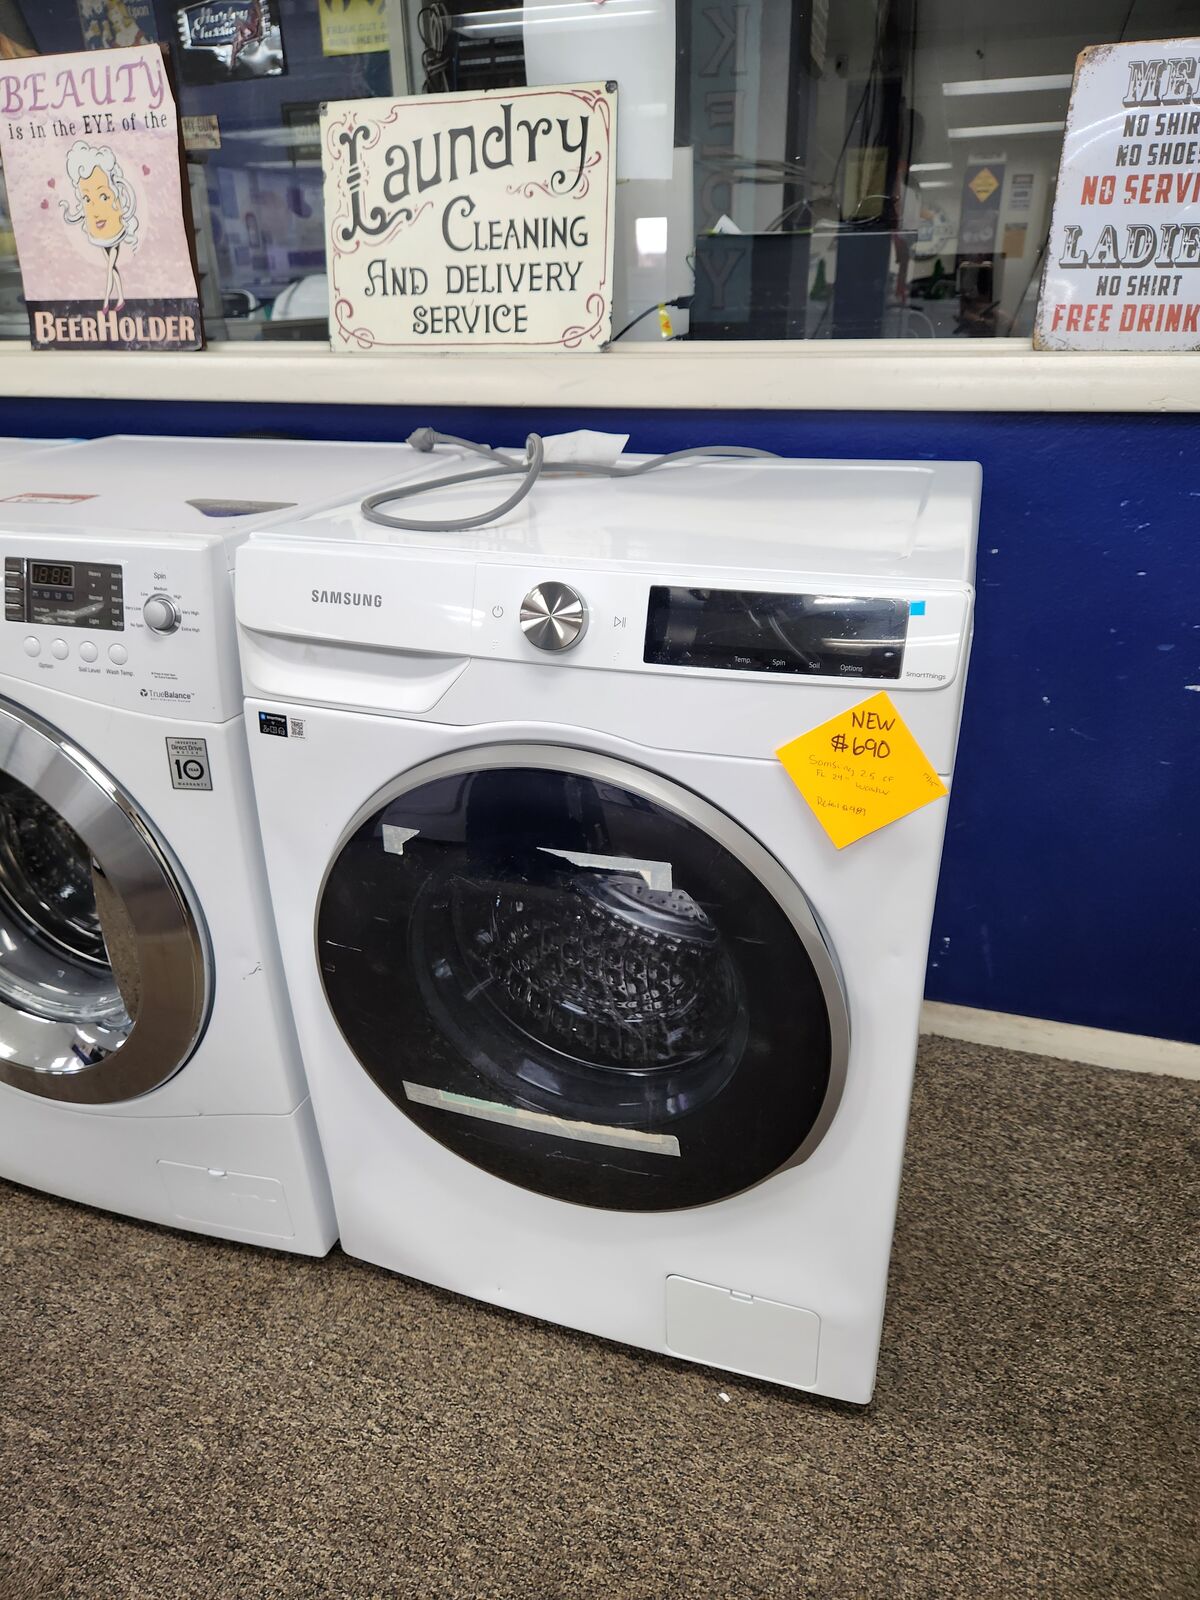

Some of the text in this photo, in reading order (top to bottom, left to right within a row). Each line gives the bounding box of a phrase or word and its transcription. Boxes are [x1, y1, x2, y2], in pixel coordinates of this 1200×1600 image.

[0, 56, 166, 114] BEAUTY
[1122, 56, 1200, 108] ME
[8, 122, 24, 141] is
[30, 120, 46, 139] in
[52, 116, 76, 137] the
[82, 113, 116, 136] EYE
[122, 112, 138, 132] of
[144, 110, 168, 130] the
[1123, 111, 1200, 137] NO SHIR
[1116, 143, 1142, 167] NO
[338, 103, 590, 241] Laundry
[1081, 172, 1200, 206] NO SERVI
[441, 195, 589, 252] CLEANING
[1058, 223, 1200, 269] LADIE
[364, 258, 584, 297] AND DELIVERY
[1096, 274, 1183, 296] NO SHIRT
[412, 304, 529, 335] SERVICE
[1051, 302, 1200, 333] FREE DRINK
[153, 572, 167, 580] Spin
[311, 589, 382, 609] SAMSUNG
[106, 668, 119, 676] Wash
[772, 658, 786, 667] Spin
[808, 661, 820, 669] Soil
[840, 664, 863, 673] Options
[905, 671, 946, 680] SmartThings
[851, 710, 896, 731] NEW
[831, 733, 891, 759] $690
[174, 759, 205, 780] 10
